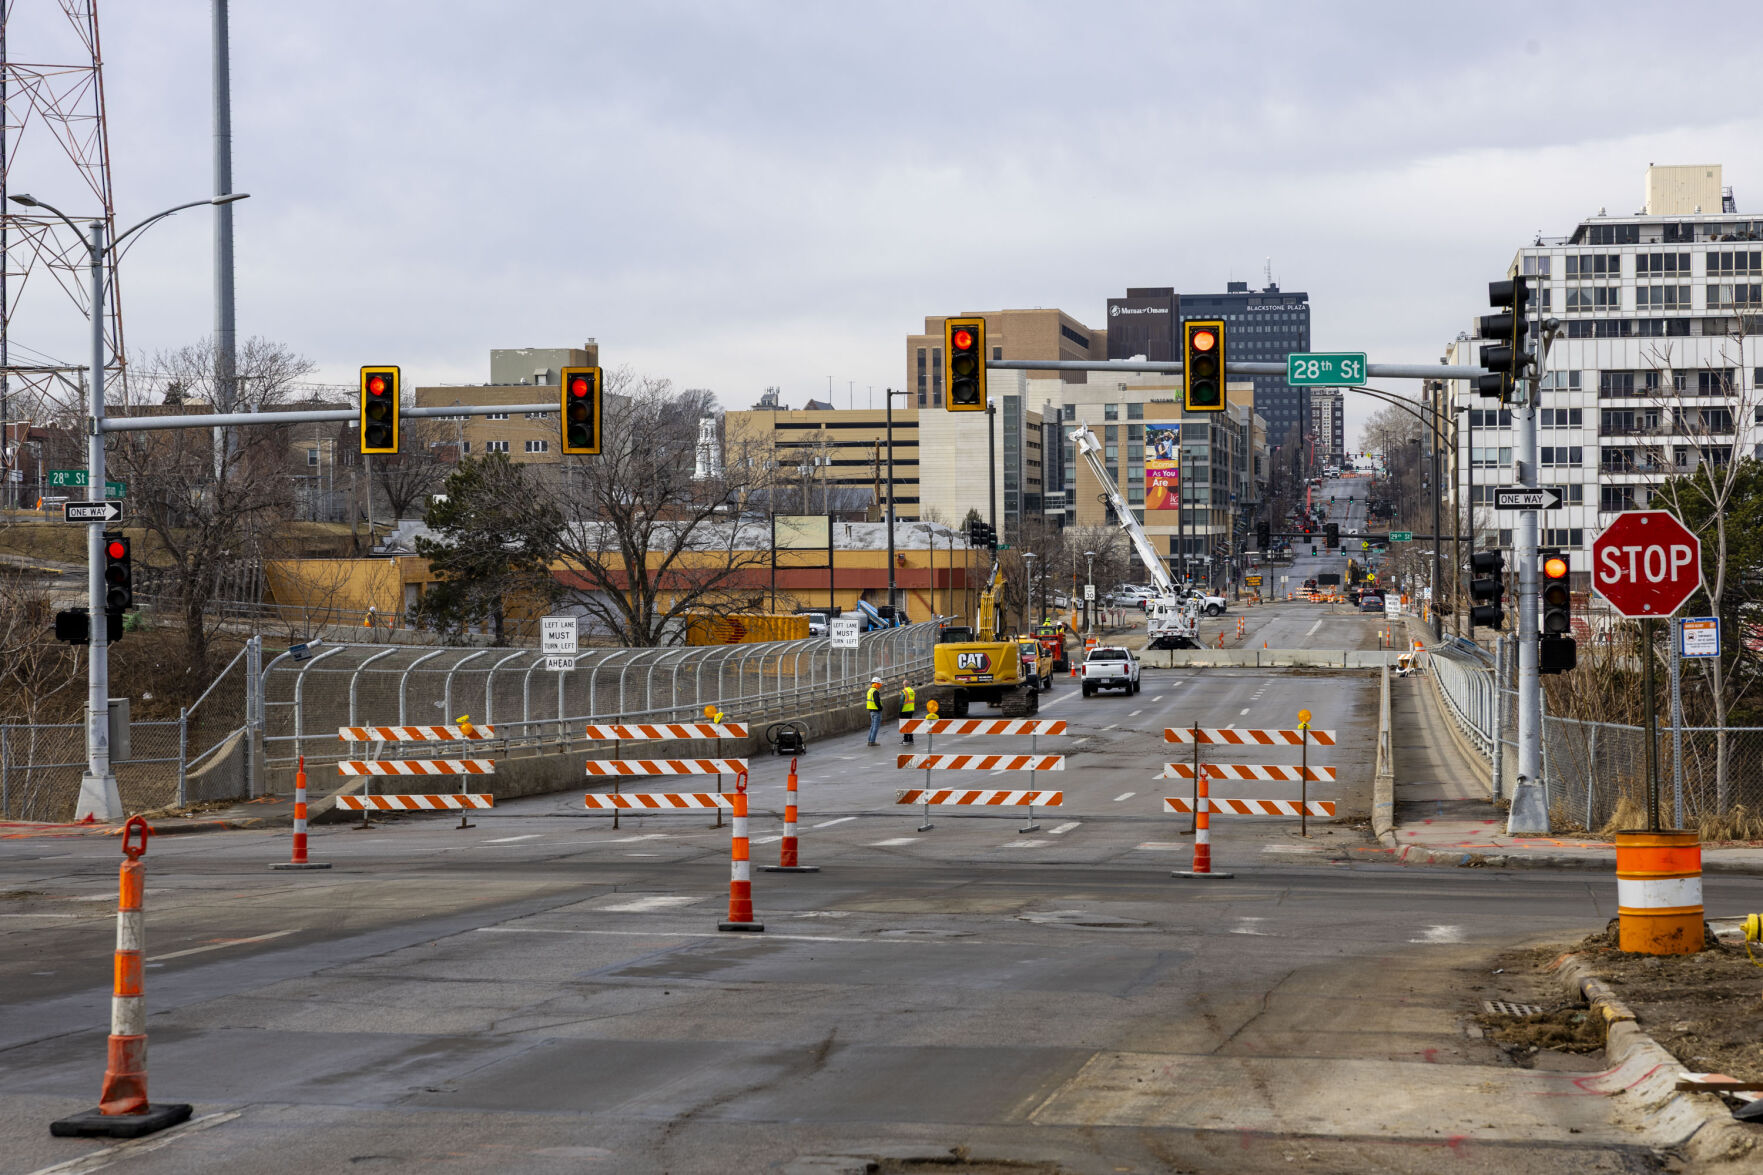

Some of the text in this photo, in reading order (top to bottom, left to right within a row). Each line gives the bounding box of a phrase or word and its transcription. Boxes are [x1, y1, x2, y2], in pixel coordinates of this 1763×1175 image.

[1293, 360, 1360, 379] 28th St
[53, 472, 86, 484] 28th St
[1152, 478, 1168, 487] Are
[1501, 495, 1544, 504] ONE WAY
[70, 508, 106, 516] ONE WAY
[1600, 544, 1692, 584] STOP
[548, 659, 573, 668] AHEAD
[958, 653, 984, 669] CAT
